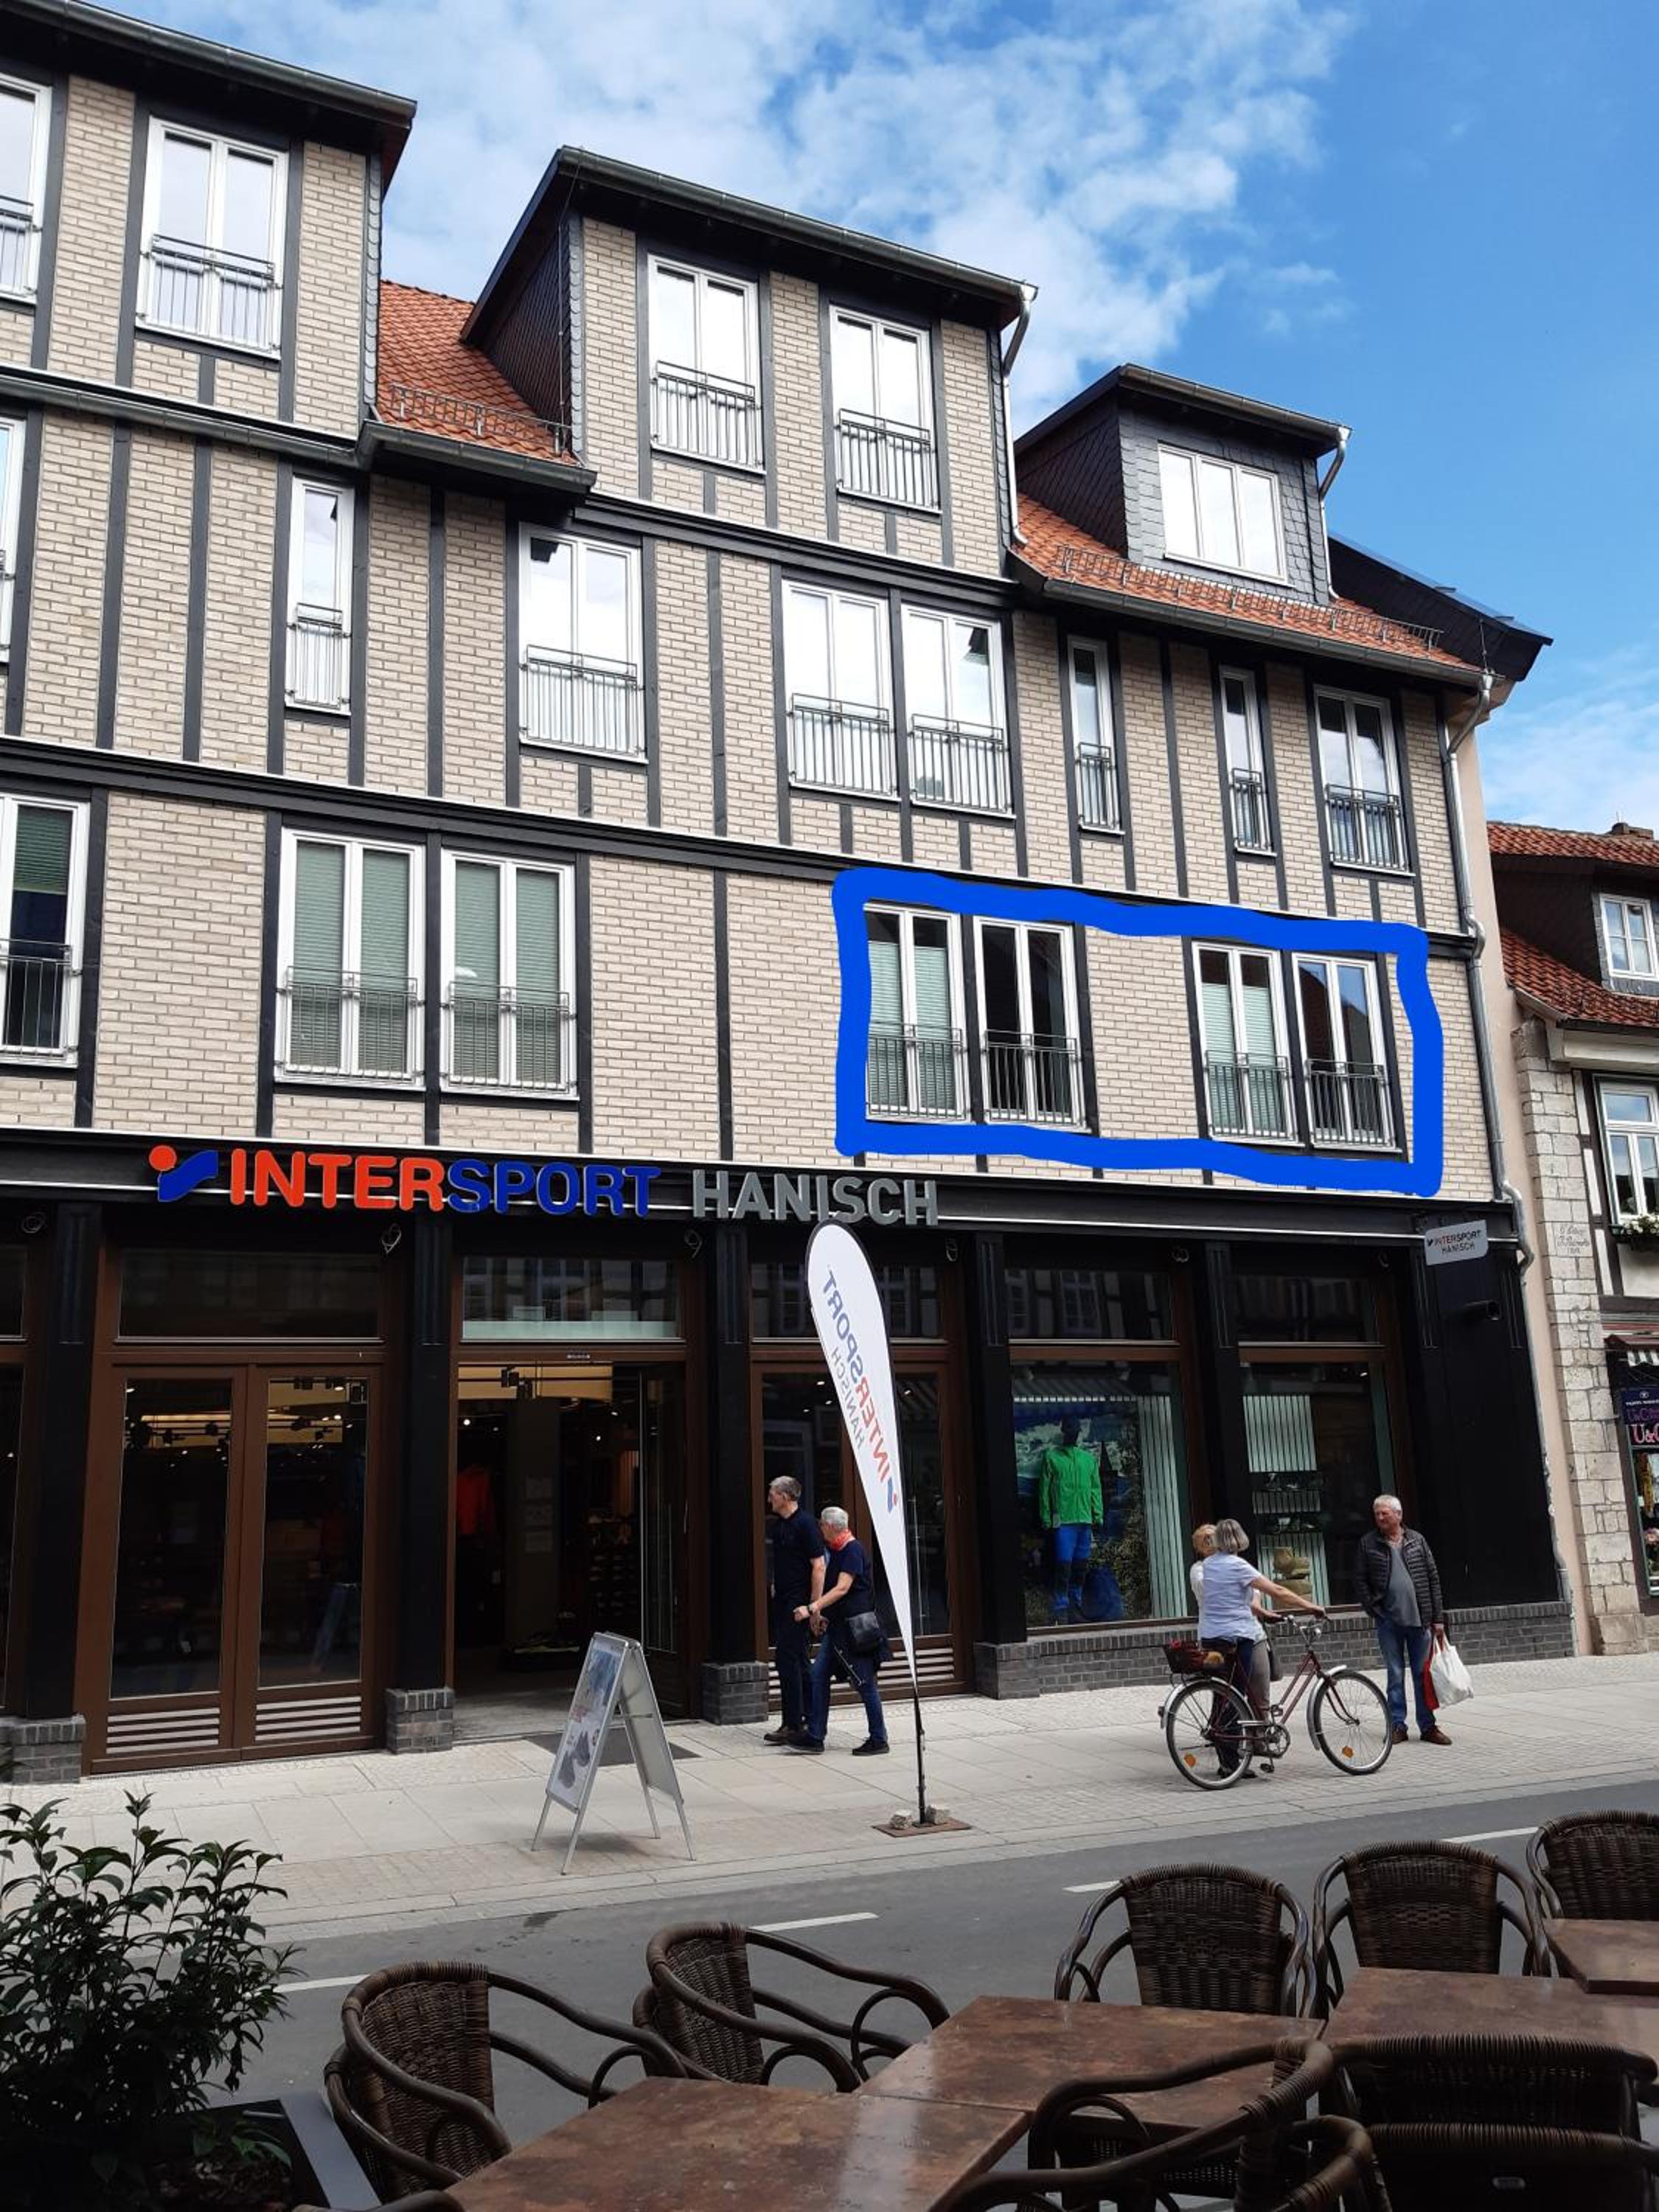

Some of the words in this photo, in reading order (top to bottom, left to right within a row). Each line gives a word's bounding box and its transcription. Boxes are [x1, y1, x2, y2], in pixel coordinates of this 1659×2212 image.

[229, 1147, 661, 1218] INTERSPORT
[692, 1169, 939, 1226] HANISCH
[1434, 1229, 1481, 1246] INTERSPORT
